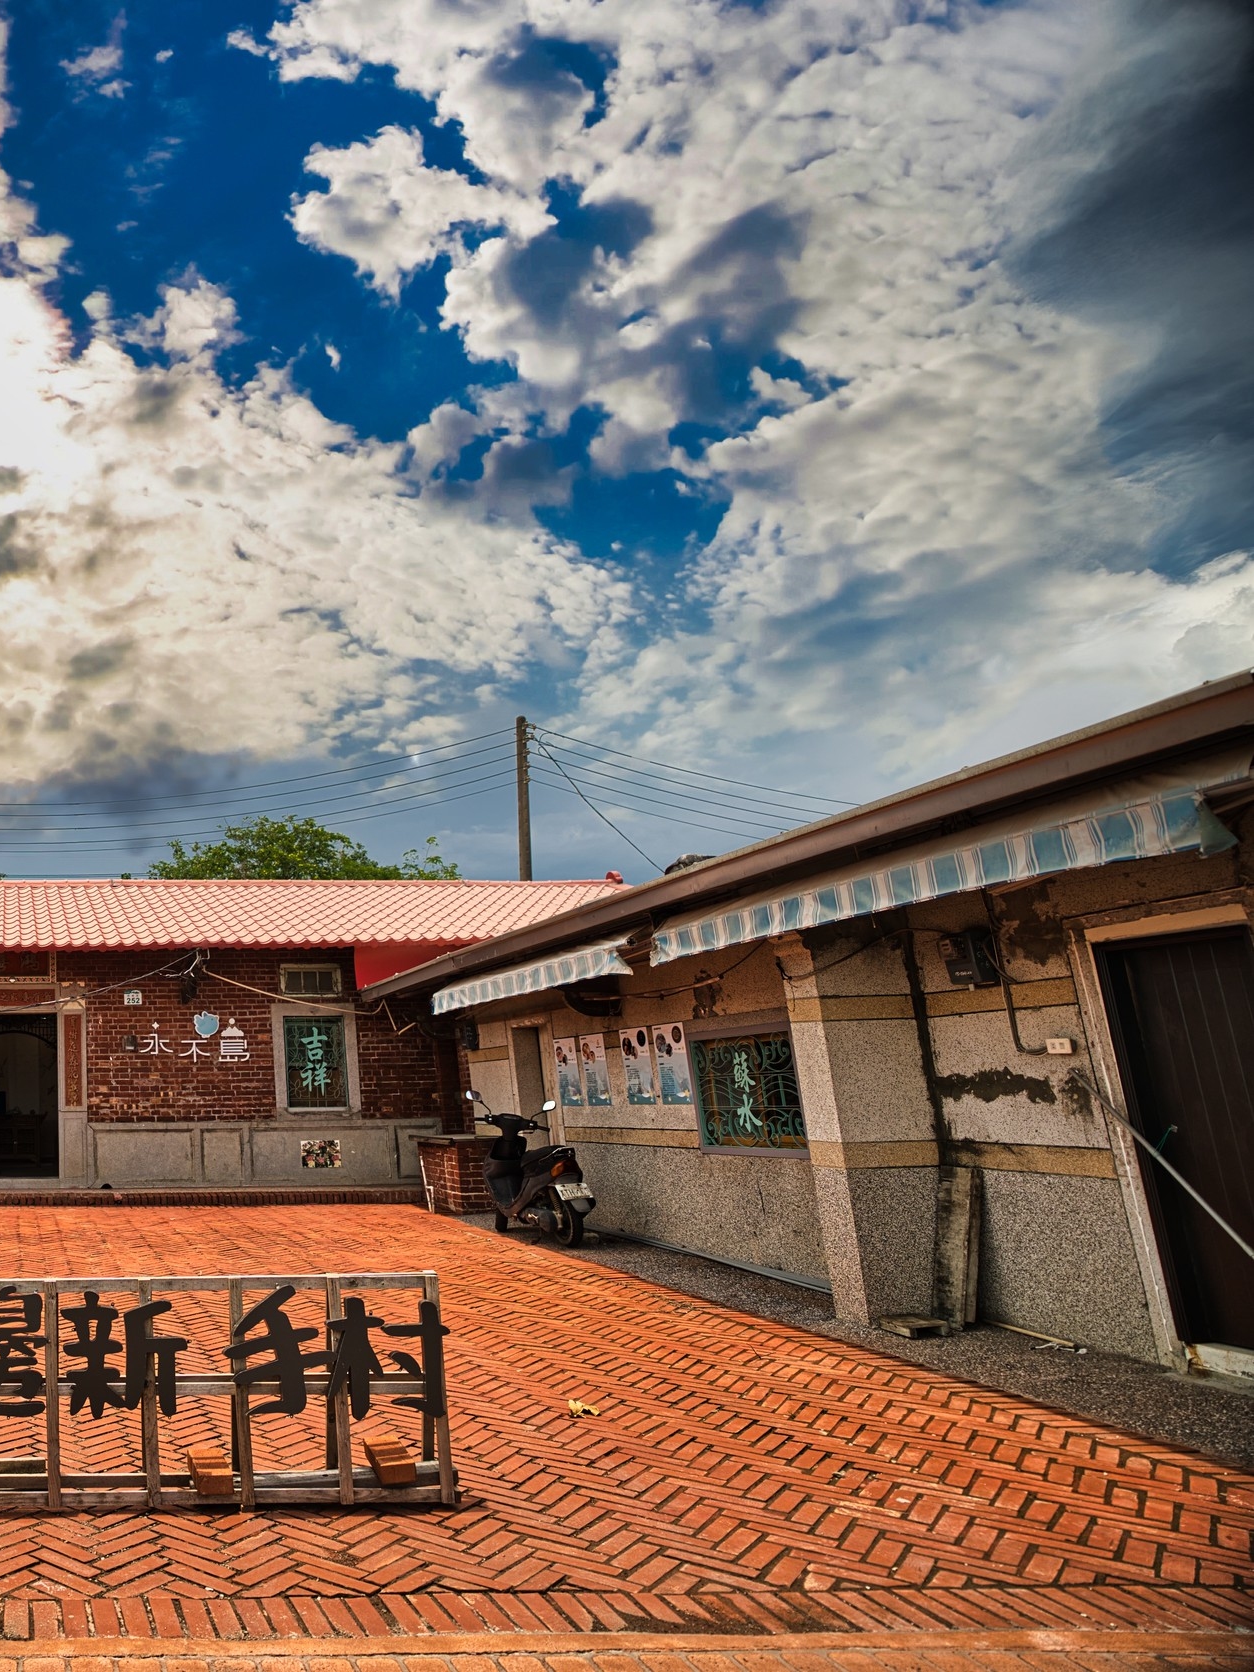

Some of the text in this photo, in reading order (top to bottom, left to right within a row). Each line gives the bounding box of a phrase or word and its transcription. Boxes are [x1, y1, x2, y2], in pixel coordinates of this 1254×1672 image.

[139, 1022, 250, 1062] 永不島
[301, 1027, 331, 1096] 吉祥
